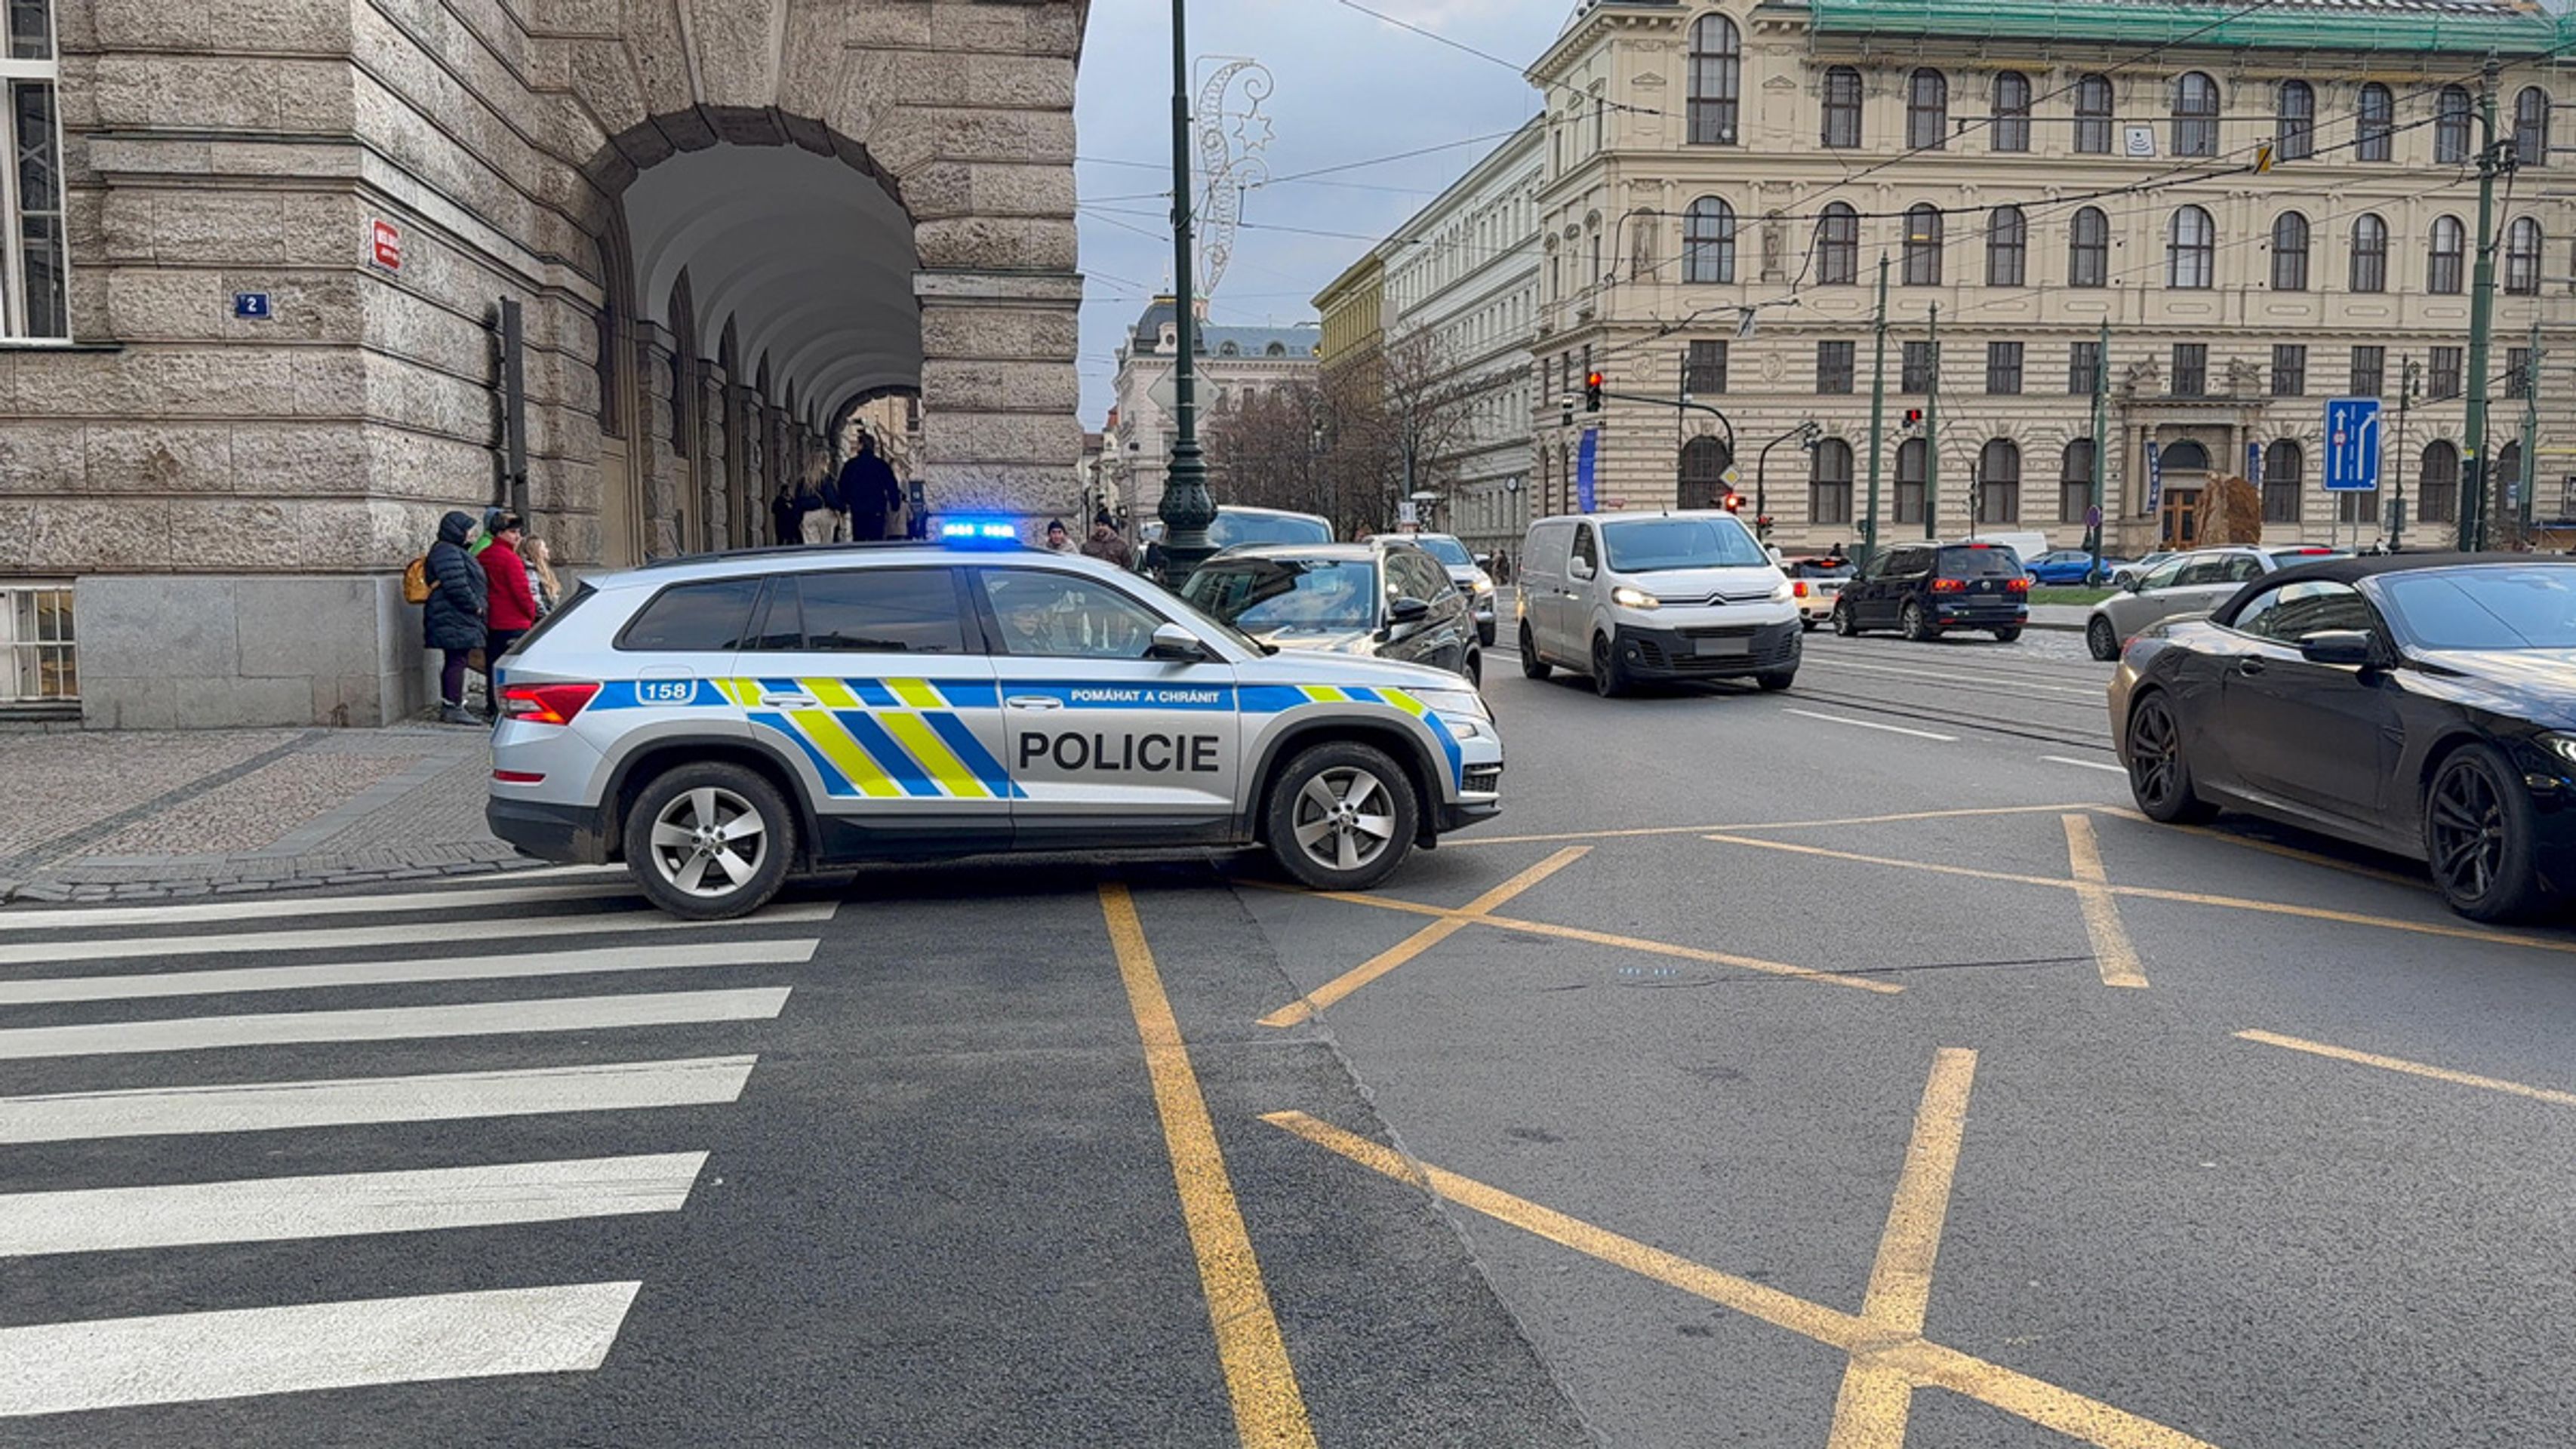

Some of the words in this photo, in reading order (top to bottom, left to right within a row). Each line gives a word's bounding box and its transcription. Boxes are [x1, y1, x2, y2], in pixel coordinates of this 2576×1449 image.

[248, 296, 257, 312] 2
[646, 683, 686, 699] 158
[1071, 688, 1139, 702] POMÁHAT
[1145, 691, 1156, 702] A
[1159, 689, 1219, 703] CHRÁNIT
[1019, 731, 1219, 771] POLICIE
